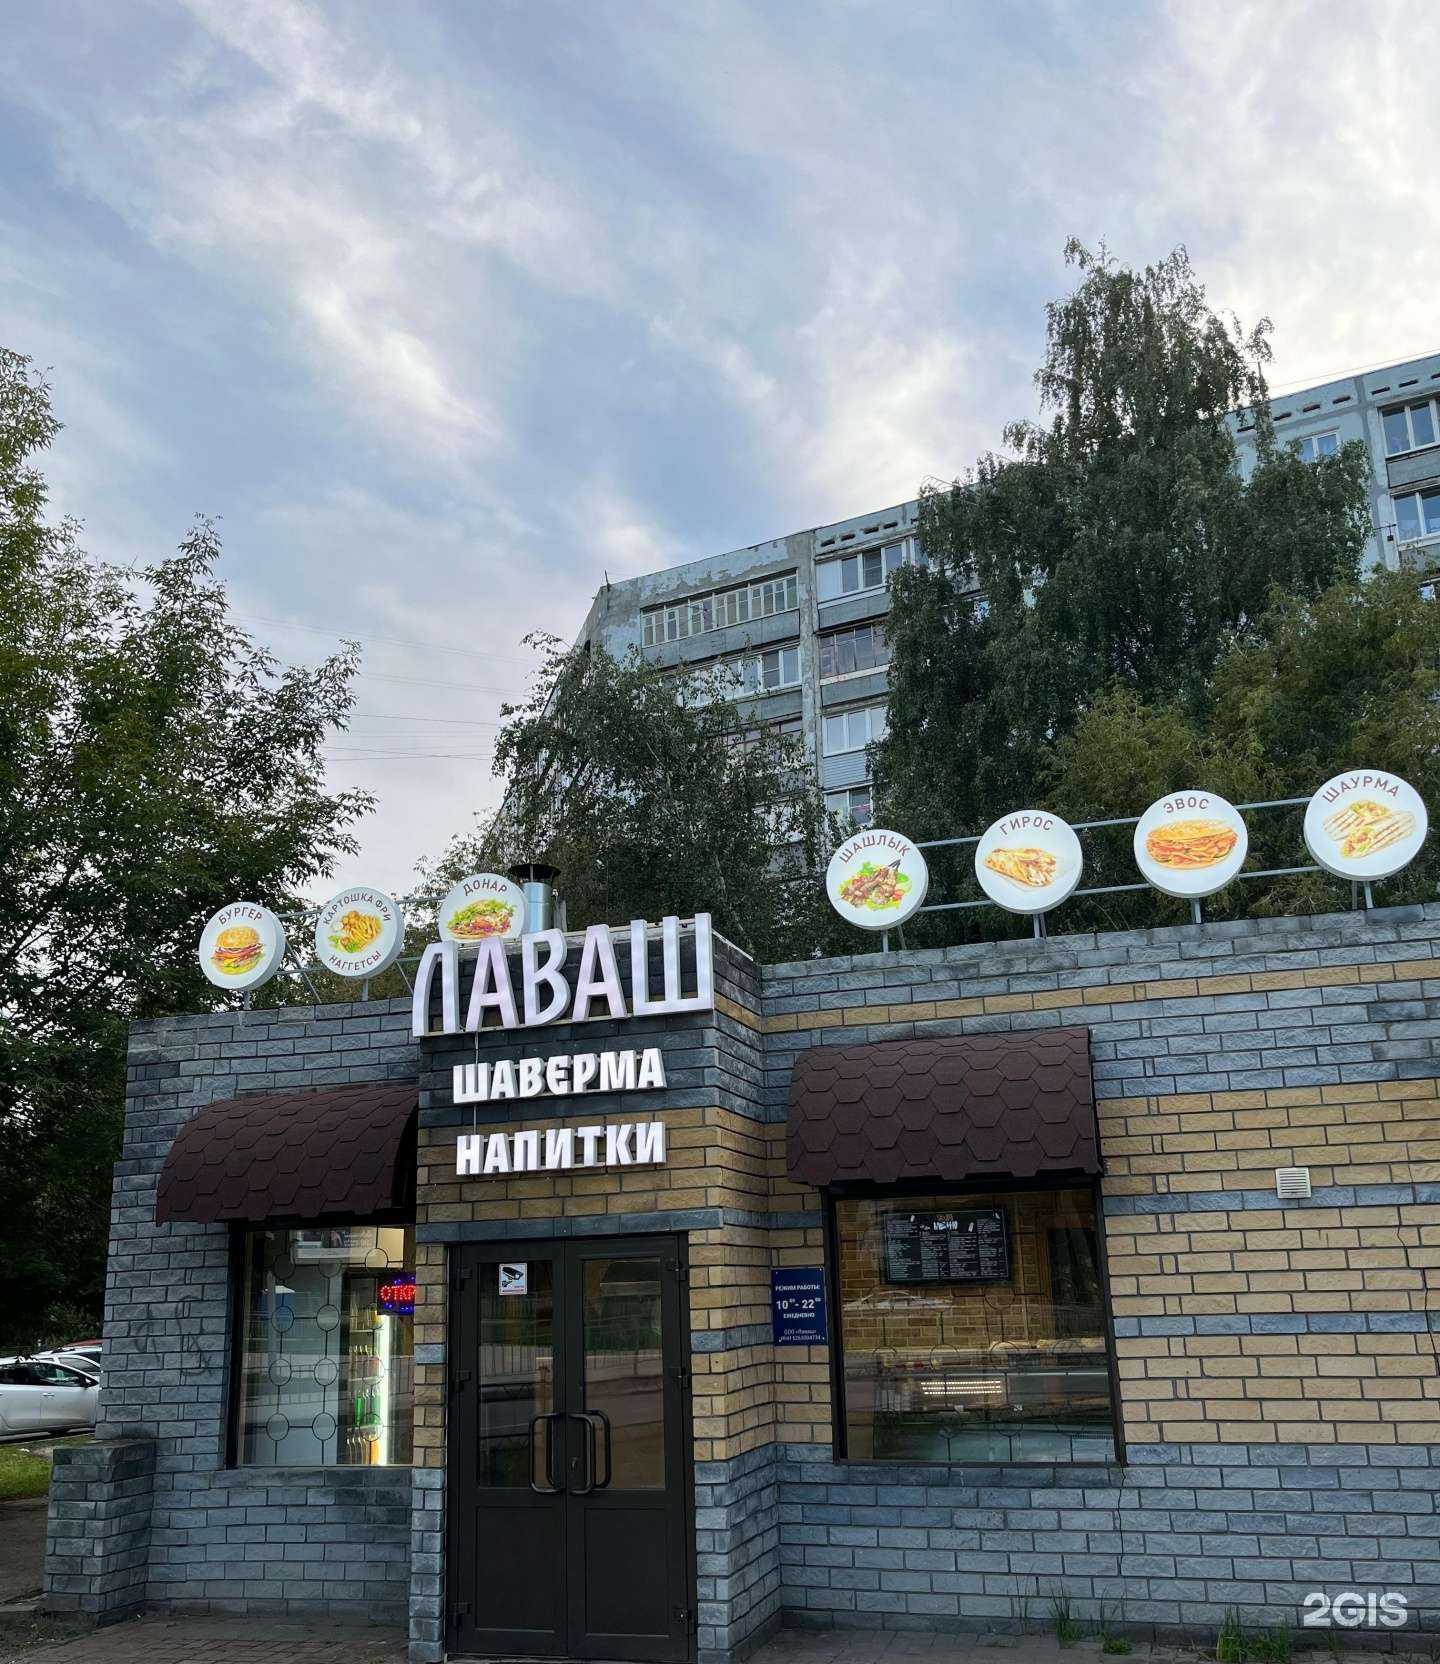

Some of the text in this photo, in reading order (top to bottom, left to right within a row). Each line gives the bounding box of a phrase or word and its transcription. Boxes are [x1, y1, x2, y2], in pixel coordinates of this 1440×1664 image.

[1323, 775, 1400, 803] ШАУРМА
[1163, 796, 1209, 813] ЭВОС
[1000, 816, 1054, 835] ГИРОС
[839, 834, 911, 864] ШАШЛЫК
[463, 878, 508, 897] ДОНАР
[218, 906, 263, 925] БУРГЕР
[323, 892, 392, 925] КАРТОШКА ФРИ
[329, 950, 382, 971] НАГГЕТСЫ
[412, 912, 714, 1037] ЛАВАШ
[453, 1048, 667, 1104] ШАВЕРМА
[456, 1121, 666, 1175] НАПИТКИ
